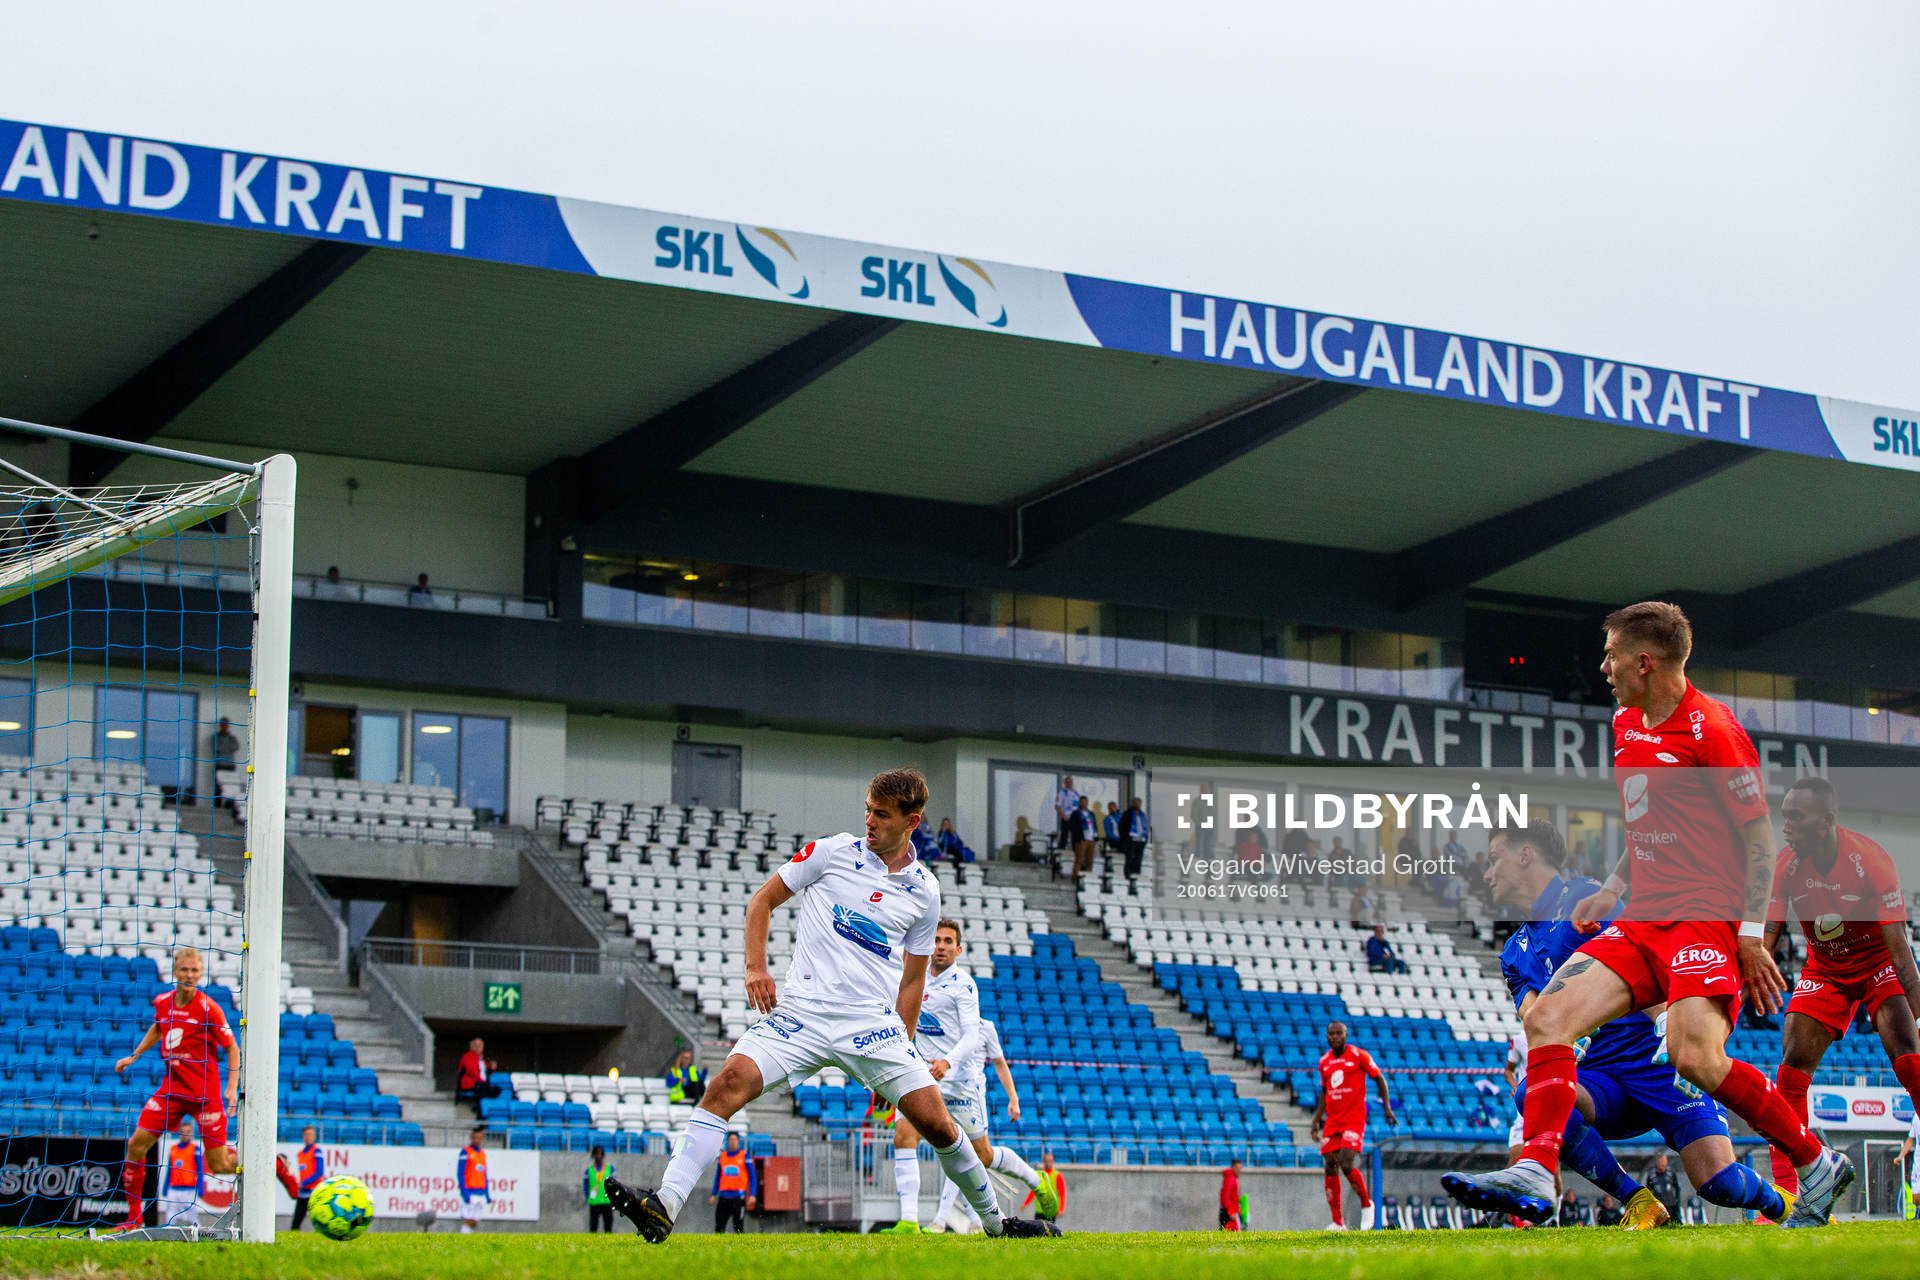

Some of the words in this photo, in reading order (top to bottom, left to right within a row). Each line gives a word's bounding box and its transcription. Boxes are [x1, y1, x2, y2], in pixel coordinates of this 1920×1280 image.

[2, 126, 191, 211] AND
[219, 152, 484, 251] KRAFT
[654, 225, 734, 277] SKL
[860, 255, 936, 307] SKL
[1170, 292, 1564, 408] HAUGALAND
[1584, 360, 1760, 440] KRAFT
[1873, 416, 1920, 457] SKL
[1291, 694, 1829, 795] KRAFTTRIEN
[1671, 948, 1727, 967] LERØY
[1873, 965, 1895, 983] LER
[1677, 1101, 1705, 1112] macron
[0, 1156, 111, 1198] store
[388, 1196, 426, 1215] Ring
